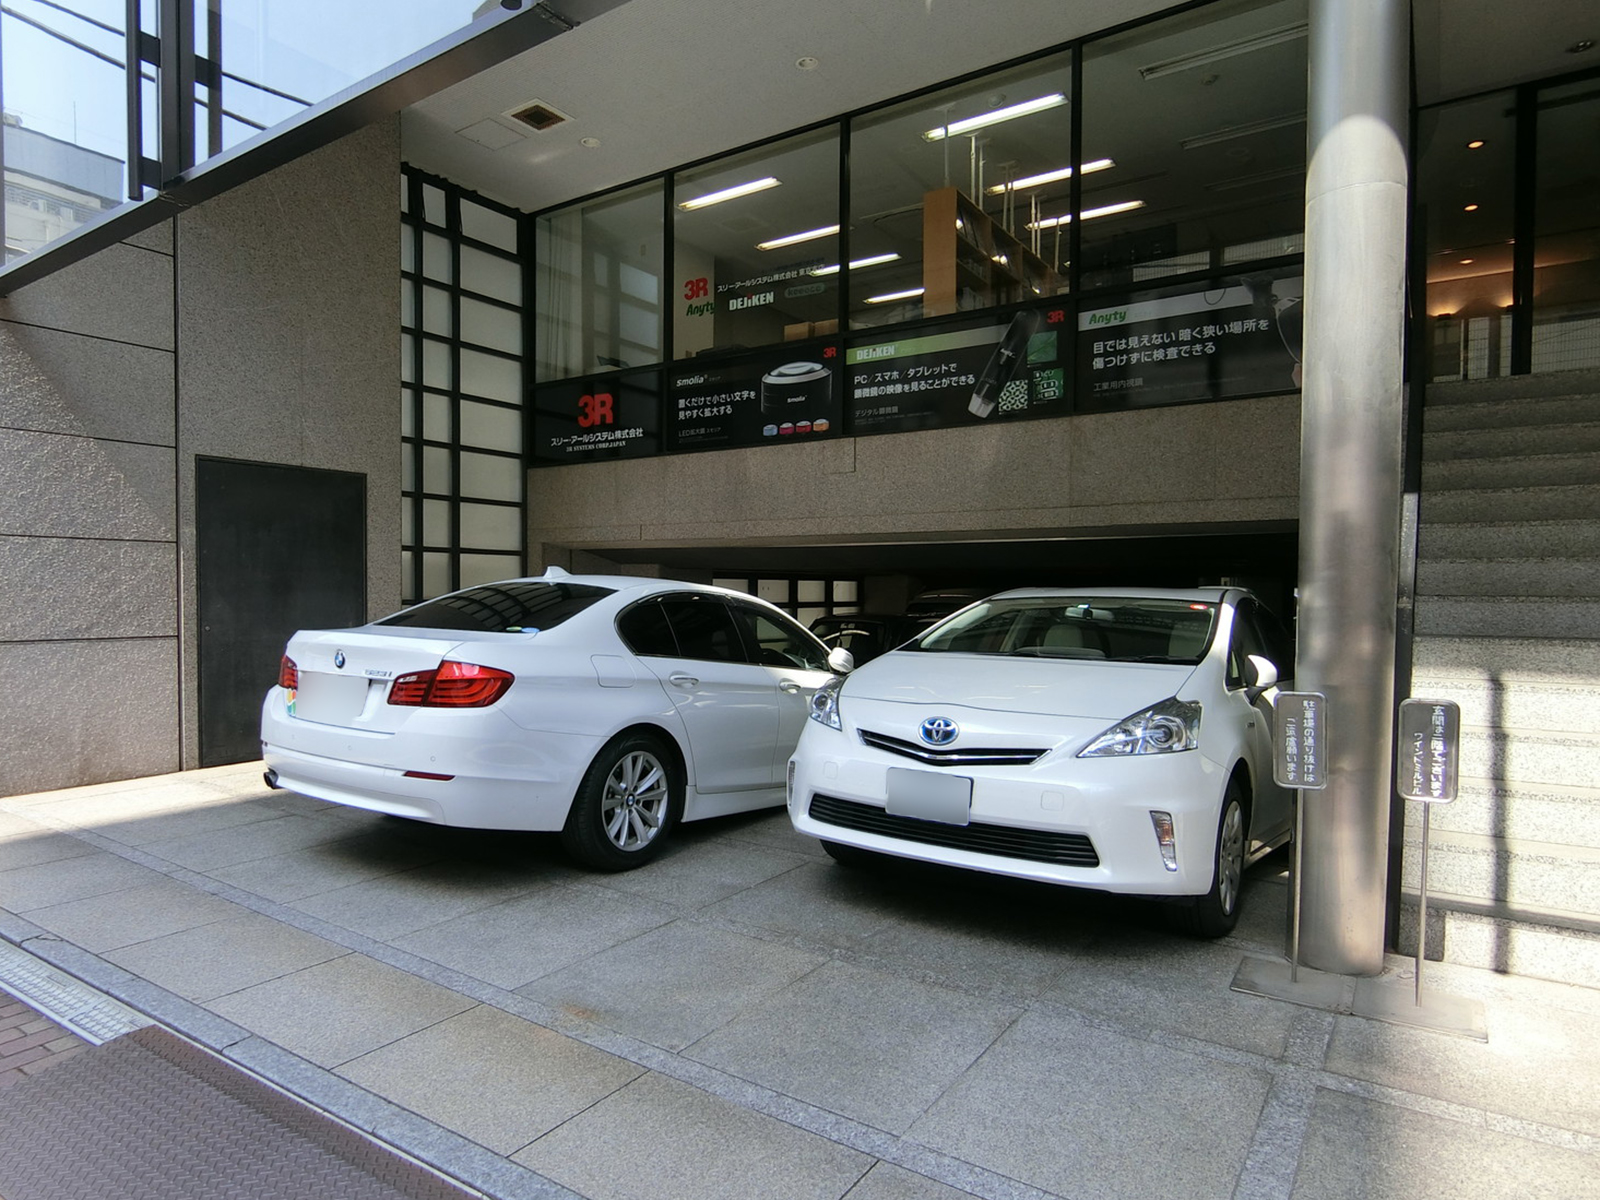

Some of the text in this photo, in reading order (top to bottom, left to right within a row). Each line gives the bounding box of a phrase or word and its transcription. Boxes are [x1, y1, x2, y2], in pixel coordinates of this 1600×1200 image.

[684, 277, 709, 301] 3R
[686, 301, 716, 317] Anyty
[1046, 310, 1065, 323] 3R
[1088, 309, 1127, 325] Anyty
[1093, 319, 1270, 355] 目では見えない 暗く狭い場所を
[823, 347, 837, 359] 3R
[1092, 342, 1216, 370] 傷つけずに検査できる
[853, 374, 976, 399] 顕微鏡の映像を見ることができる
[678, 390, 756, 408] 置くだけで小さい文字を
[577, 392, 614, 428] 3R
[678, 404, 733, 421] 見やすく拡大する
[1302, 700, 1316, 783] 駐車場の通り抜けは
